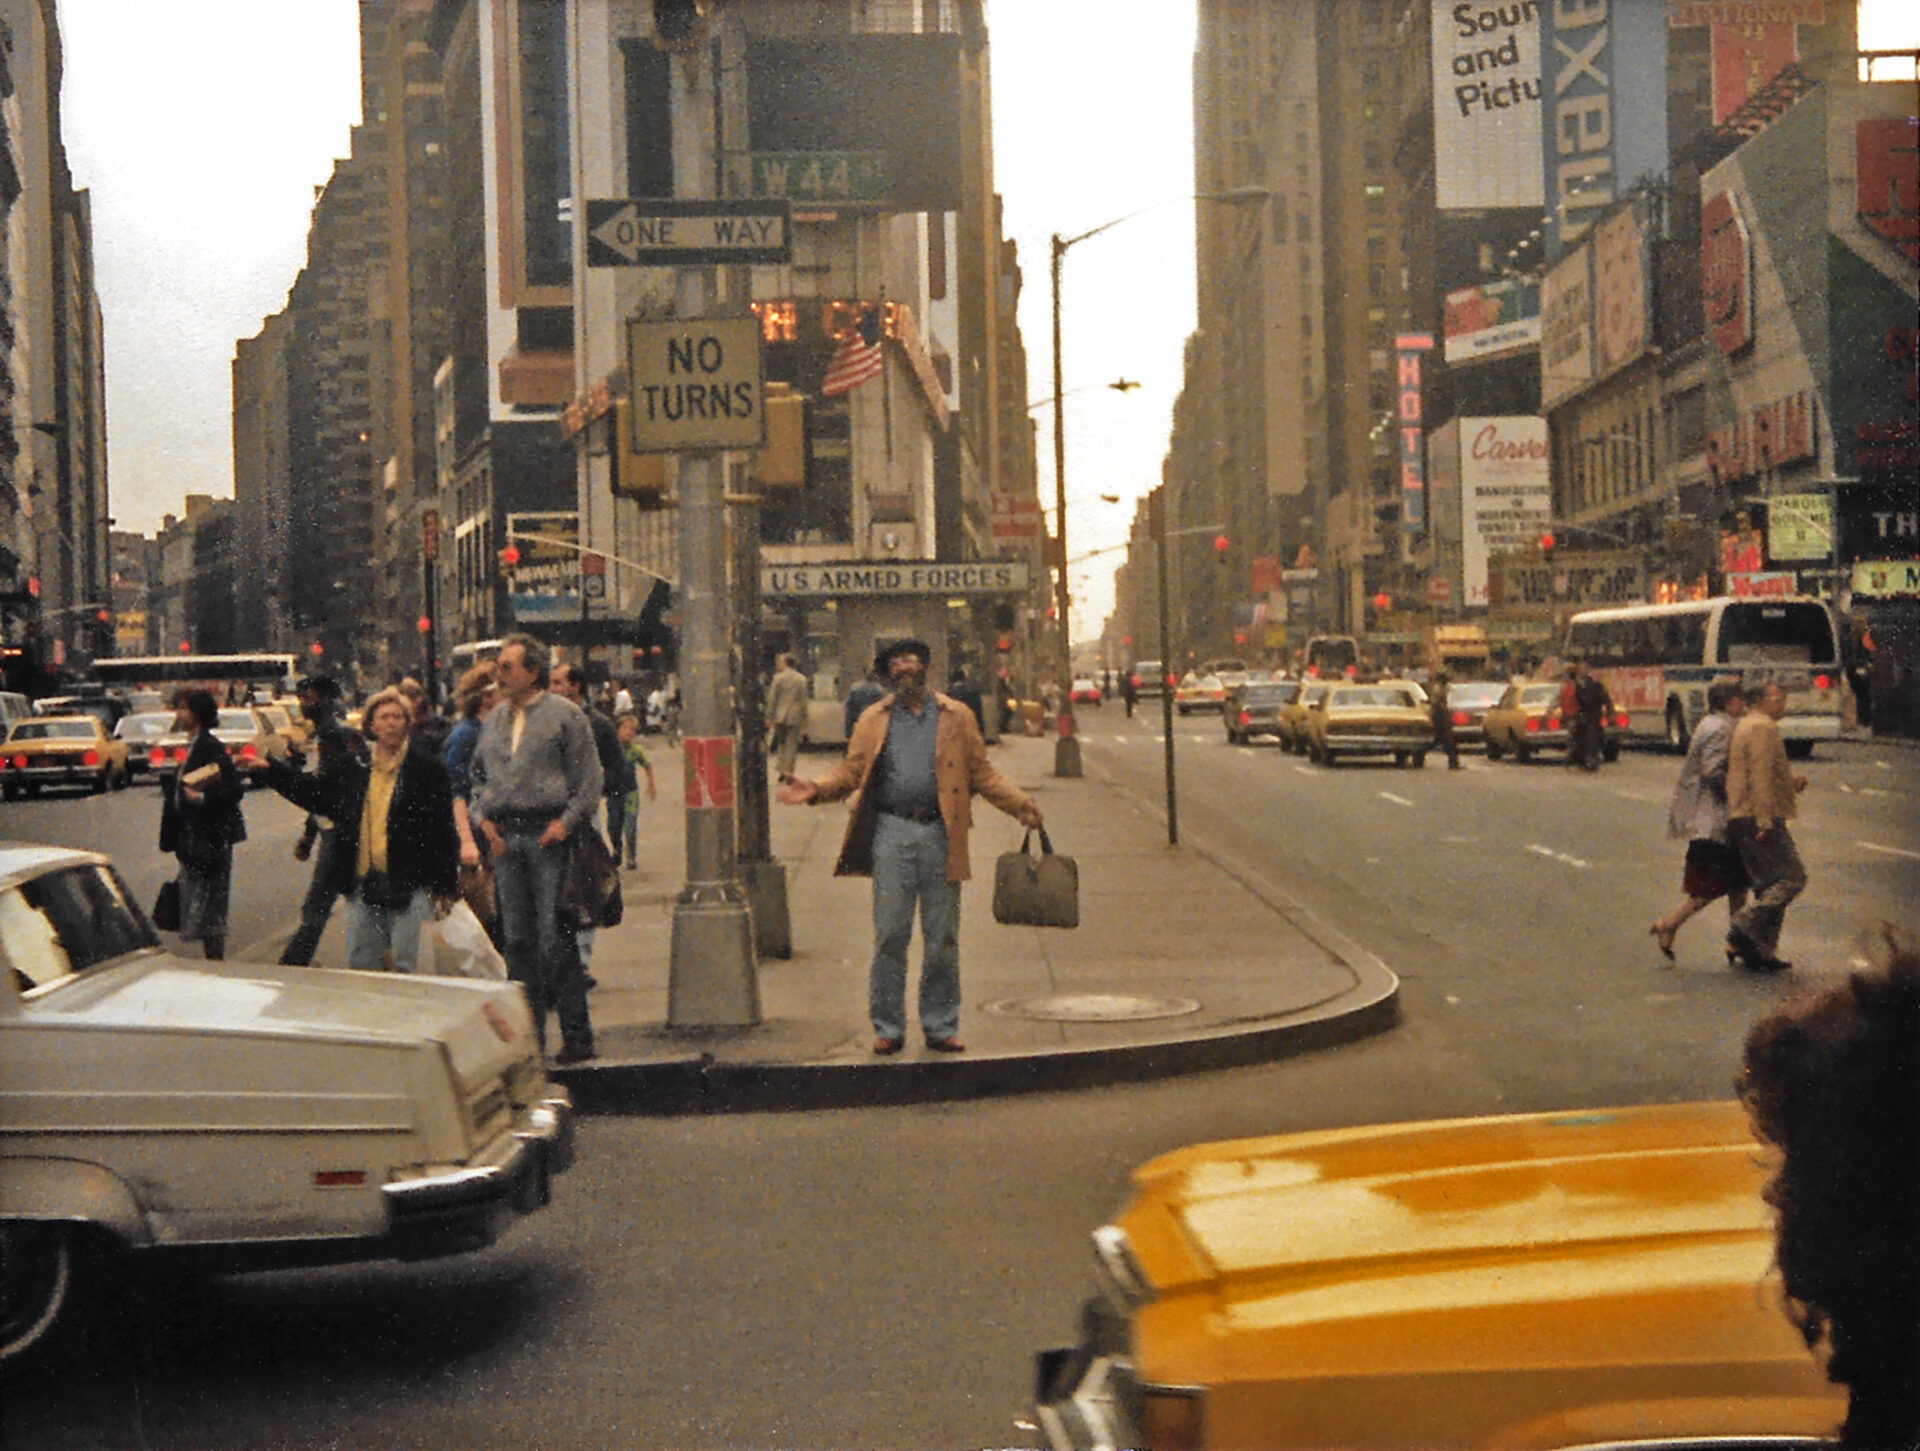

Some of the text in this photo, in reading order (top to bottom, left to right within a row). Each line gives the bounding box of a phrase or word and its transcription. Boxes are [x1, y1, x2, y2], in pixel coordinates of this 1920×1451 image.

[1452, 34, 1520, 76] and
[762, 160, 789, 197] W
[801, 158, 850, 198] 44
[616, 218, 773, 245] ONE WAY
[668, 337, 723, 375] NO
[641, 381, 753, 421] TURNS
[1398, 356, 1424, 524] HOTEL
[818, 569, 901, 590] ARMED
[911, 568, 1011, 588] FORCES
